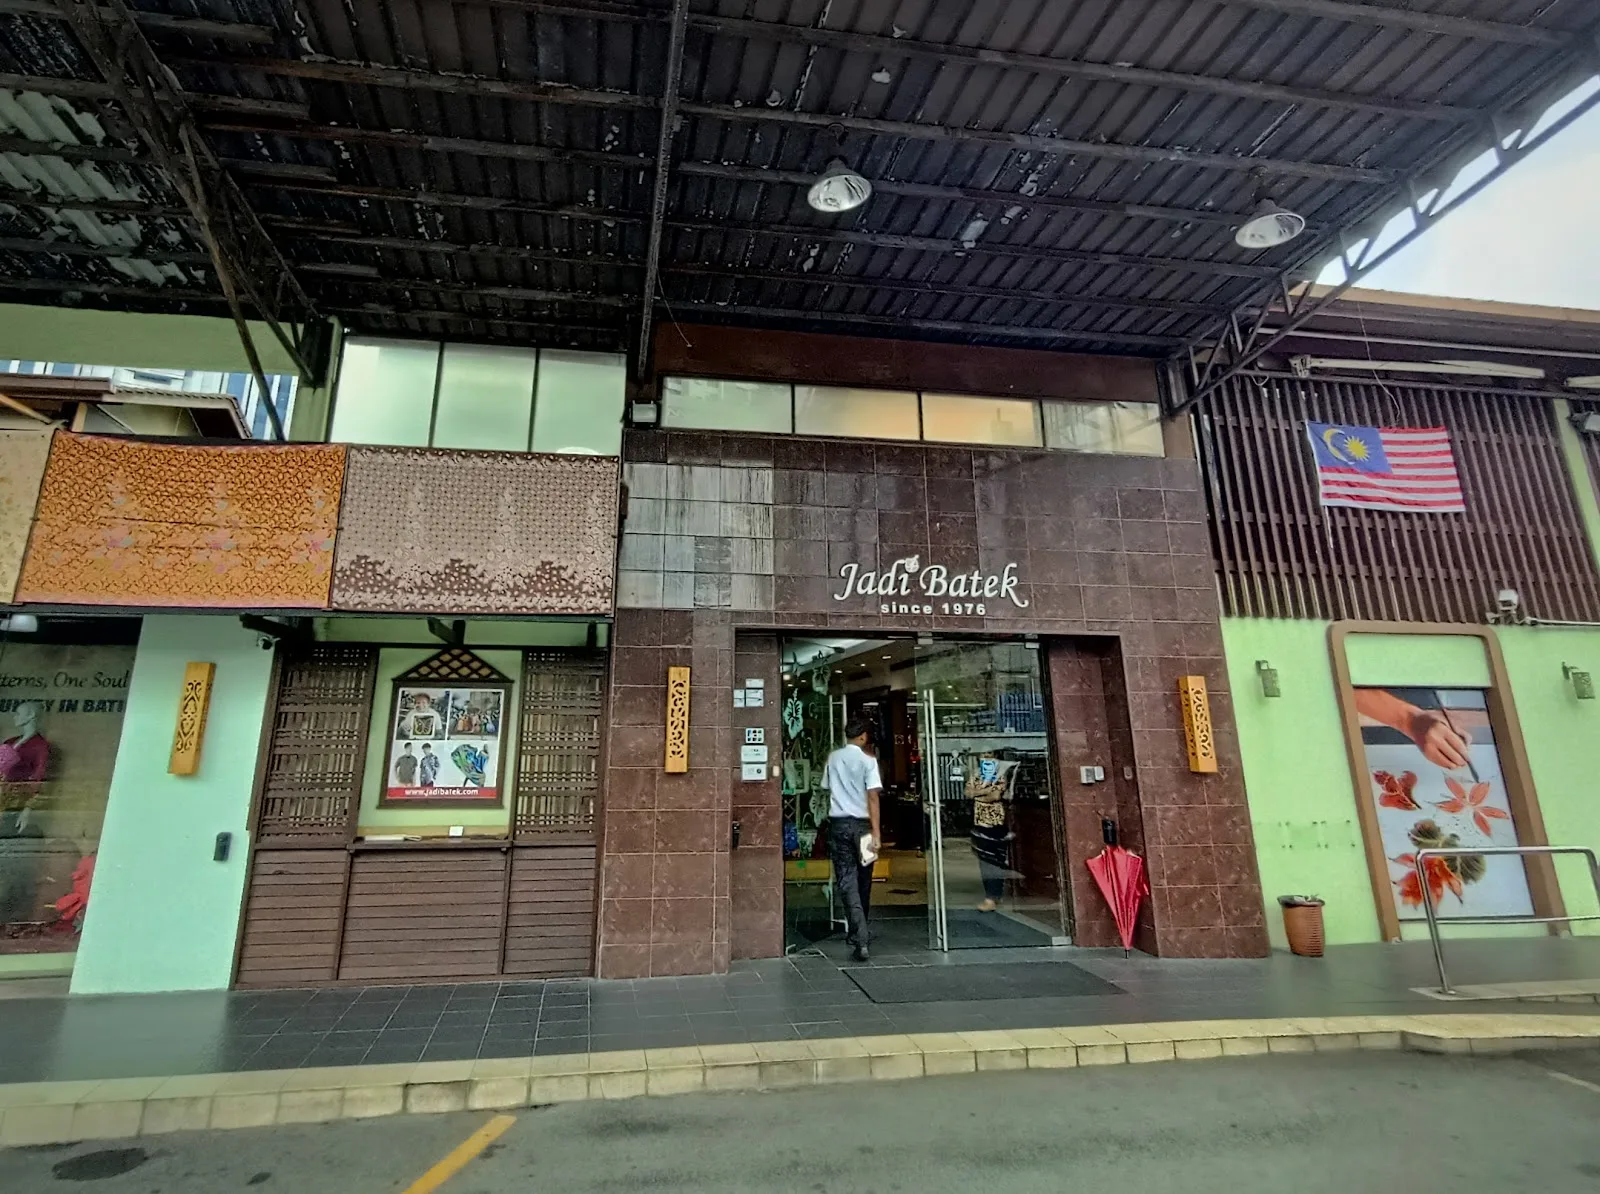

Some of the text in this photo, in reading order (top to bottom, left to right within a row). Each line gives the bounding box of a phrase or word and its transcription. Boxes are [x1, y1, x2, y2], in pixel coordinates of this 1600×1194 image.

[834, 556, 1029, 607] Jadi Batek
[881, 602, 985, 615] since 1976
[54, 671, 88, 687] One
[92, 670, 130, 688] Soul
[59, 699, 78, 712] IN
[404, 788, 479, 796] www.jadibatek.com
